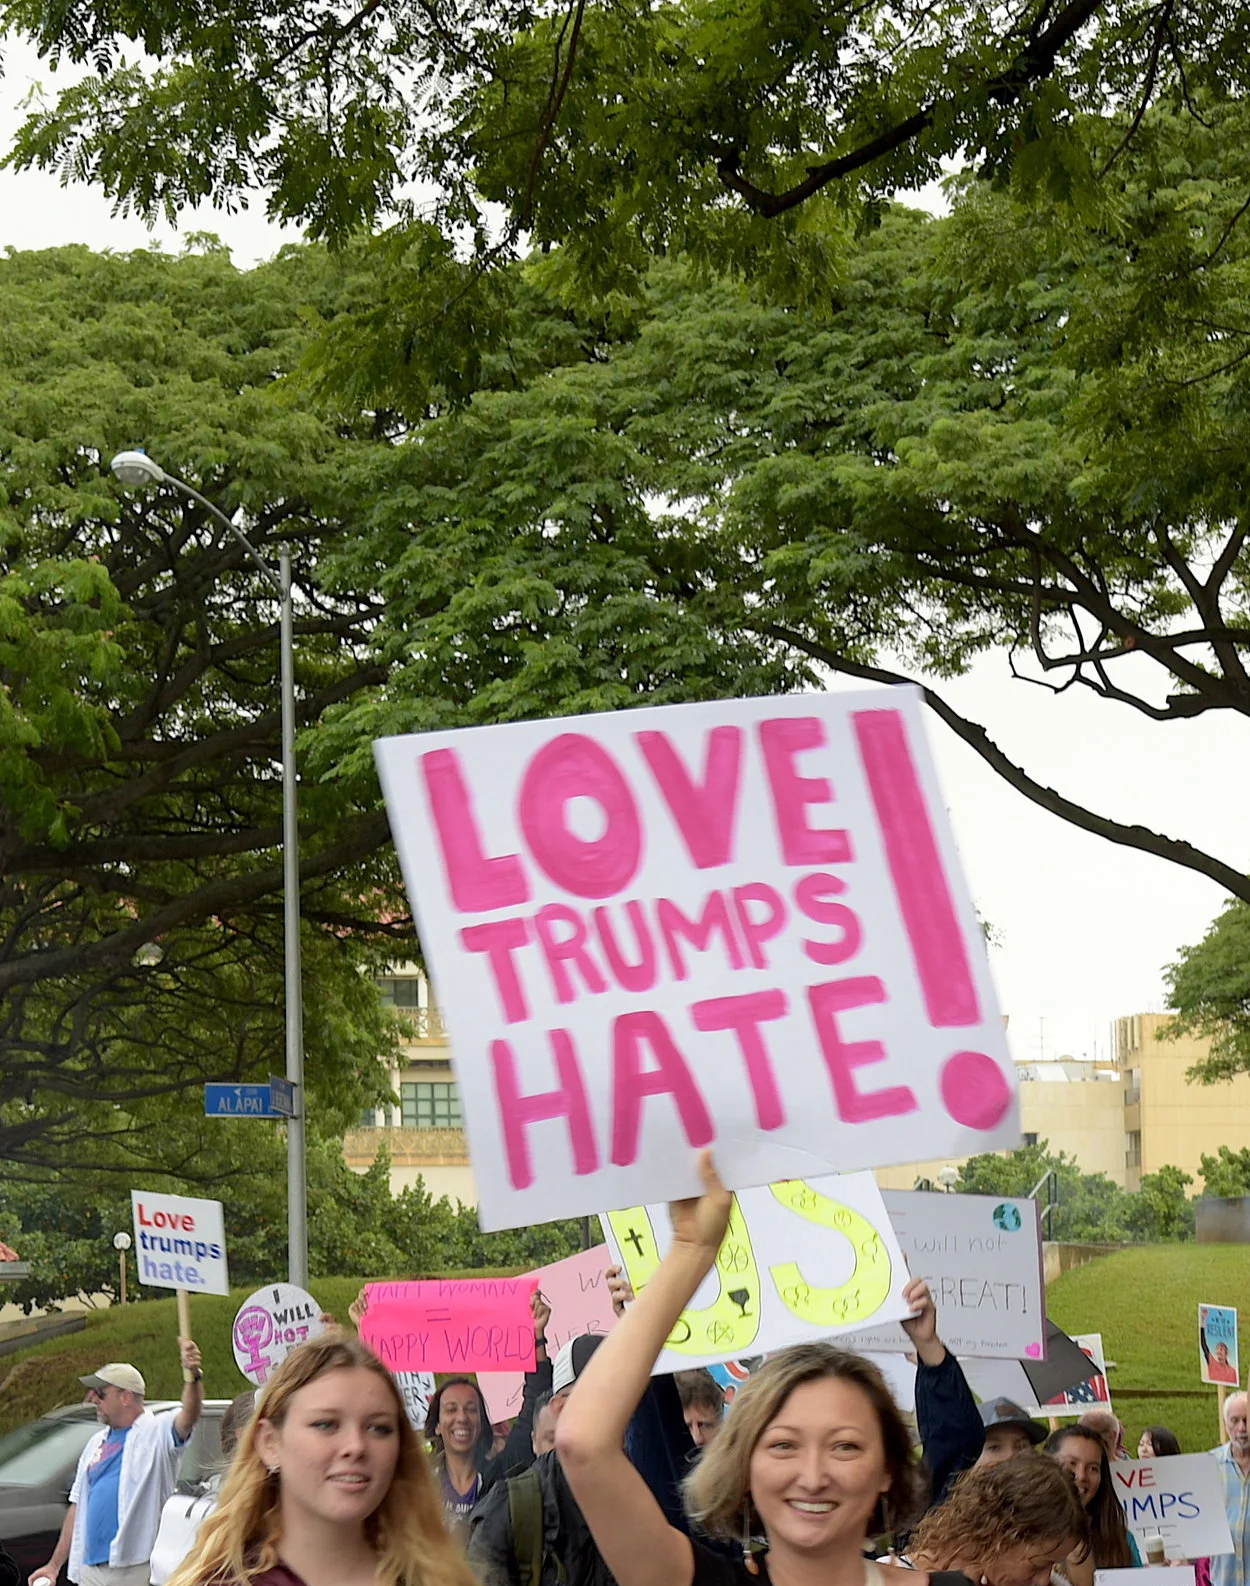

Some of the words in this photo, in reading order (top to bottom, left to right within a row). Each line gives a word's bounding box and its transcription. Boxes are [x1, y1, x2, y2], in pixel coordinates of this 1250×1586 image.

[420, 715, 857, 913] LOVE
[457, 872, 863, 1025] TRUMPS
[487, 975, 920, 1192] HATE
[137, 1203, 195, 1232] Love
[139, 1230, 223, 1263] trumps
[913, 1233, 958, 1252] will
[968, 1234, 1008, 1252] not
[143, 1254, 206, 1285] hate.
[272, 1302, 315, 1325] WILL
[274, 1325, 310, 1346] NOT
[444, 1325, 534, 1364] WORLD
